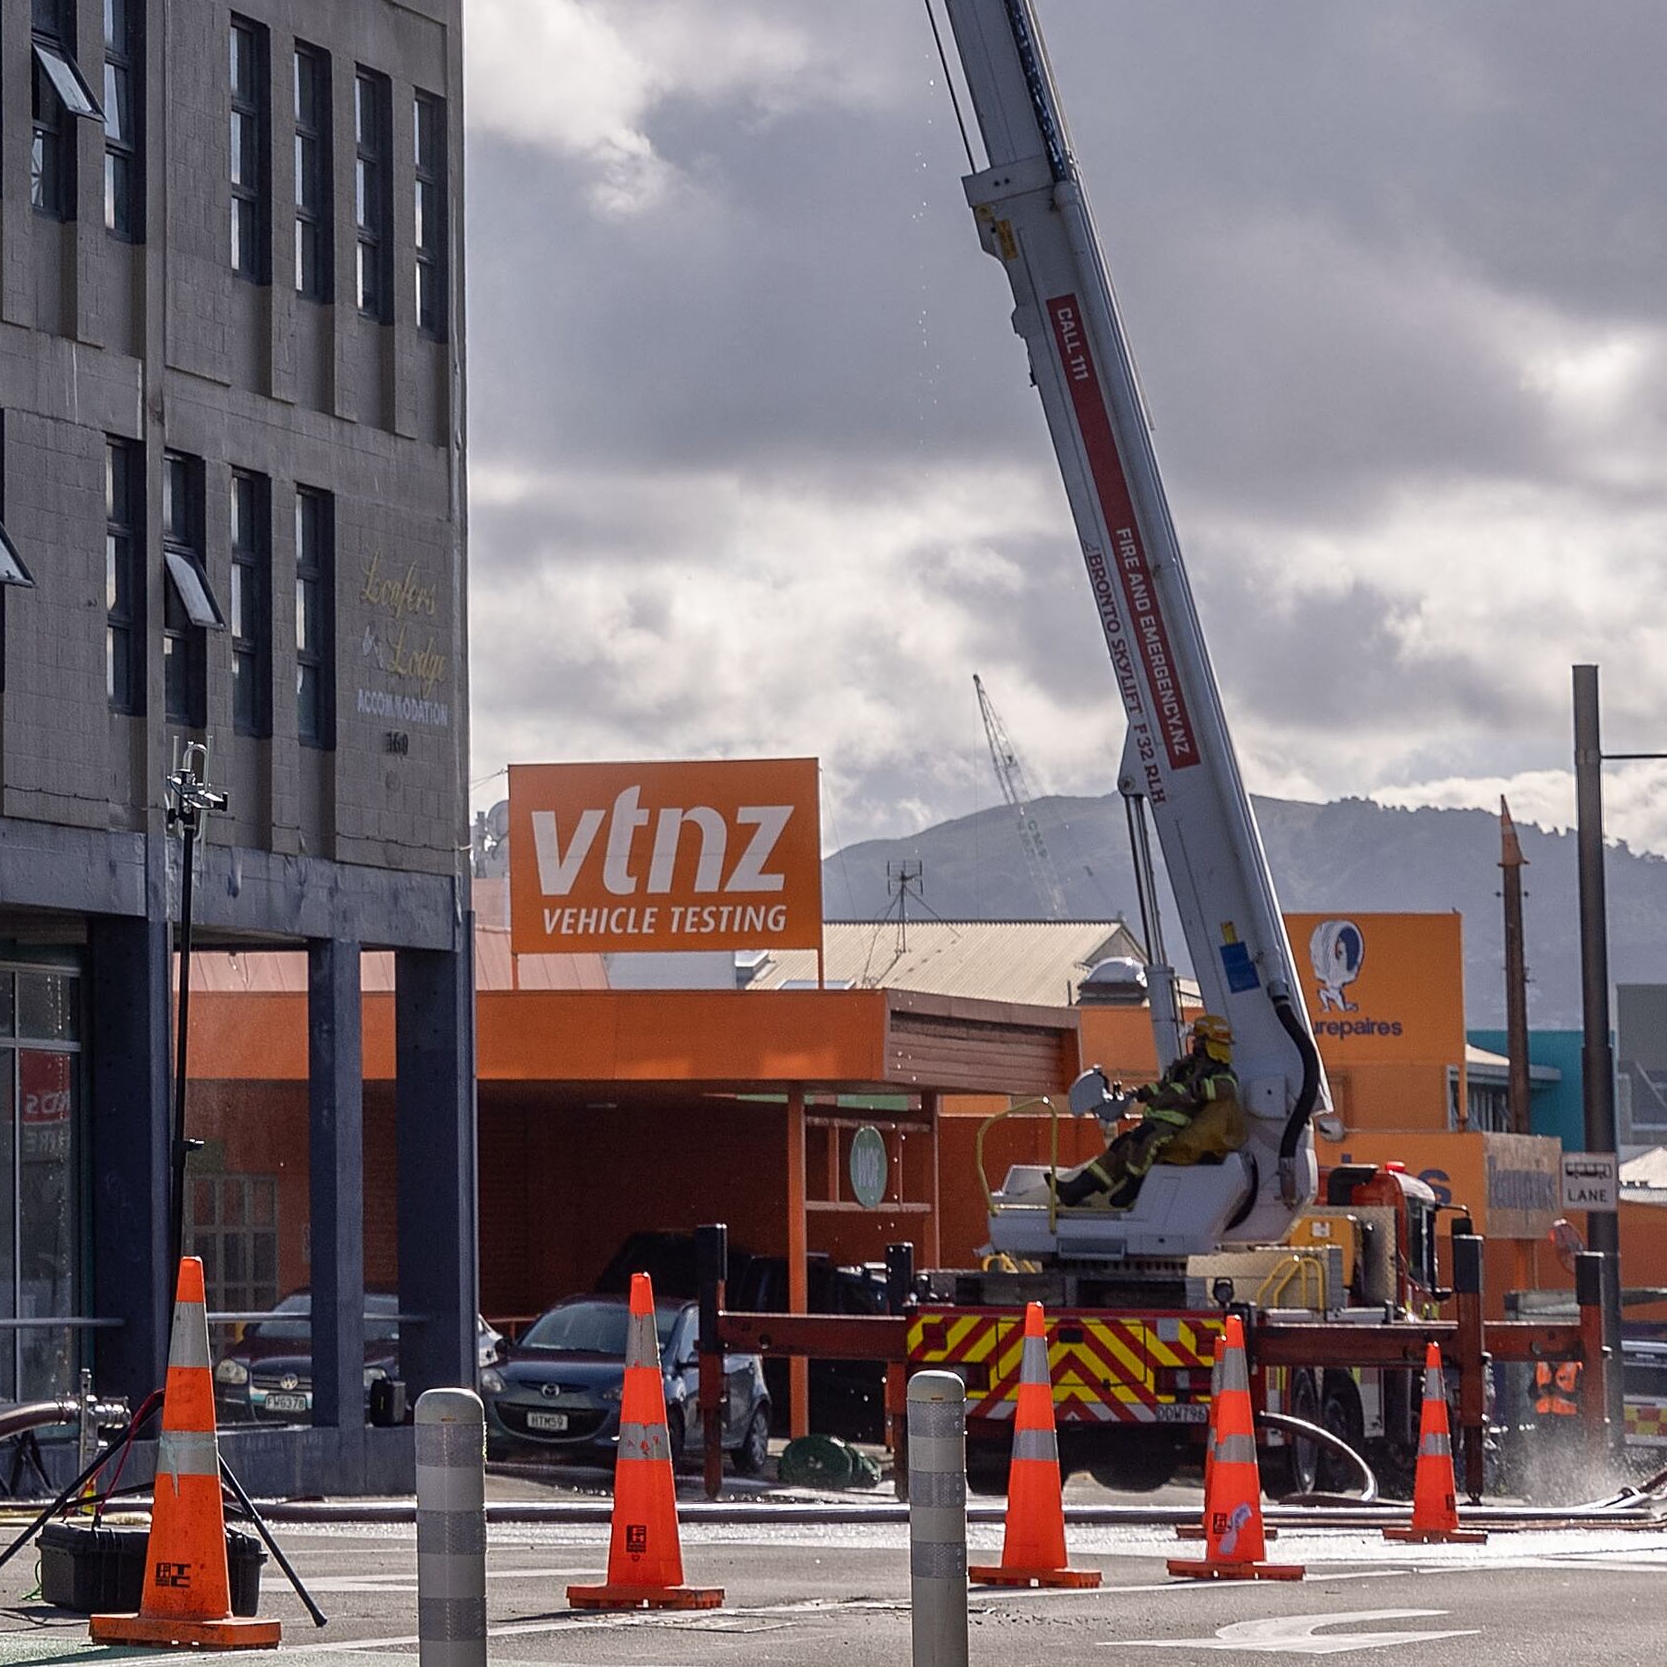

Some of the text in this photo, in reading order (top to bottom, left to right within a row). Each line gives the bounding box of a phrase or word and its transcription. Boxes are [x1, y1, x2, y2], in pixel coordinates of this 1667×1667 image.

[1057, 307, 1089, 380] CALL 111
[361, 548, 436, 620] Loafers
[386, 622, 448, 698] Lodge
[1116, 527, 1191, 757] FIRE AND EMERGENCY.NZ
[357, 689, 449, 726] ACCOMMODATION
[1088, 551, 1122, 633] BRONTO
[1111, 636, 1144, 716] SKYLIFT
[1144, 764, 1166, 807] RLH
[531, 785, 794, 896] vtnz
[543, 905, 787, 935] VEHICLE TESTING
[1568, 1188, 1607, 1203] LANE
